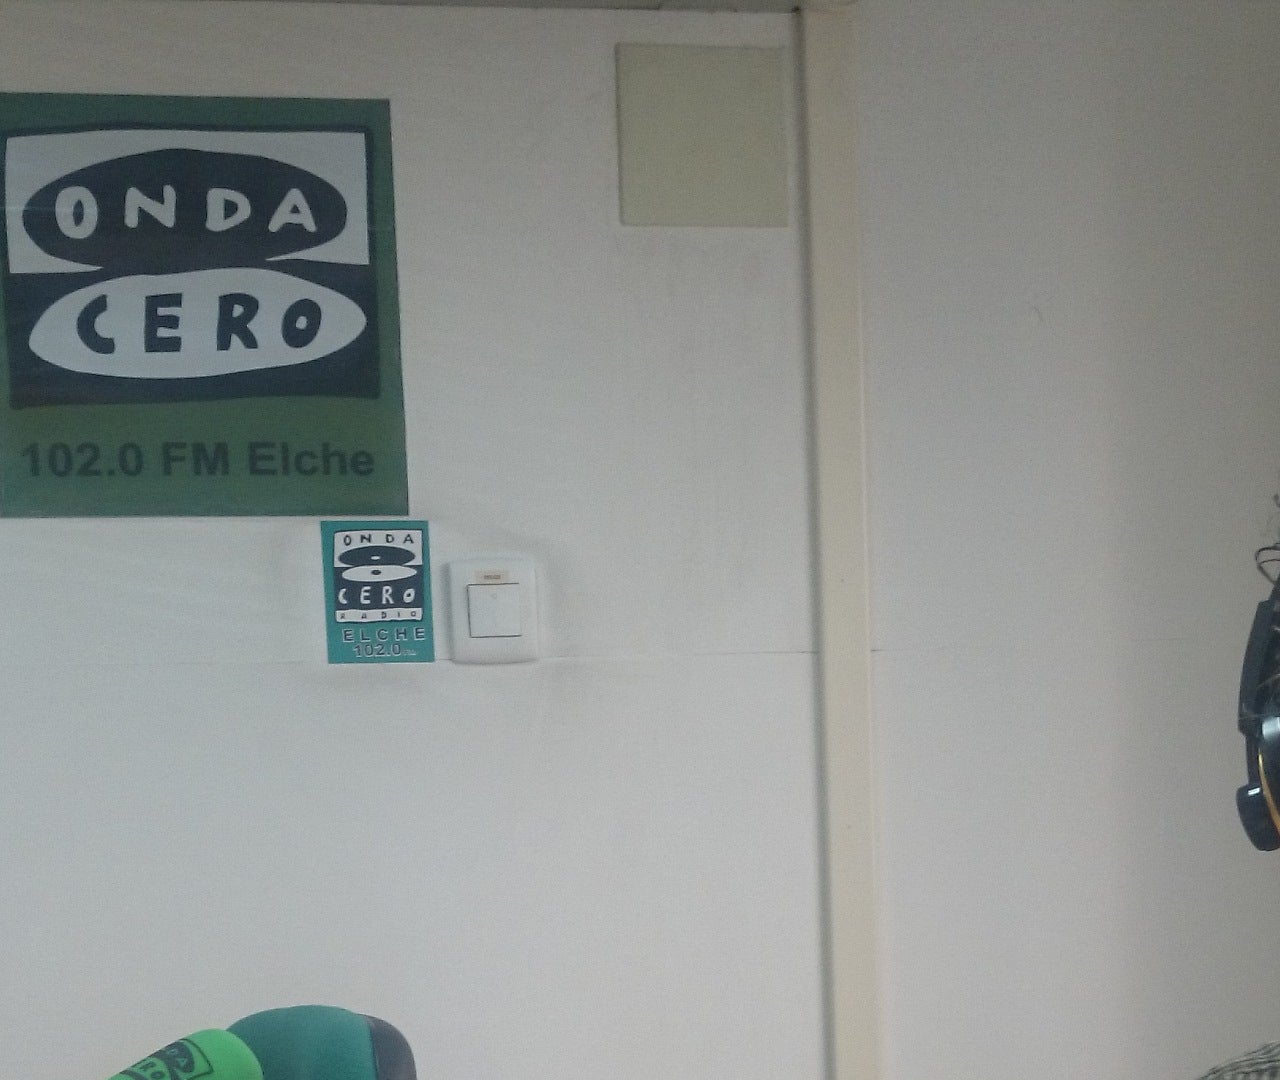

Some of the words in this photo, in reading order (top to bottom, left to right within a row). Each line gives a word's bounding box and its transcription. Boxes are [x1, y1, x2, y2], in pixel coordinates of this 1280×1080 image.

[54, 184, 318, 239] ONDA
[75, 292, 322, 355] CERO
[21, 441, 145, 477] 102.0
[163, 442, 230, 476] FM
[248, 441, 376, 477] Elche
[343, 534, 414, 546] ONDA
[337, 585, 416, 605] CERO
[342, 627, 426, 642] ELCHE
[353, 643, 402, 657] 102.0
